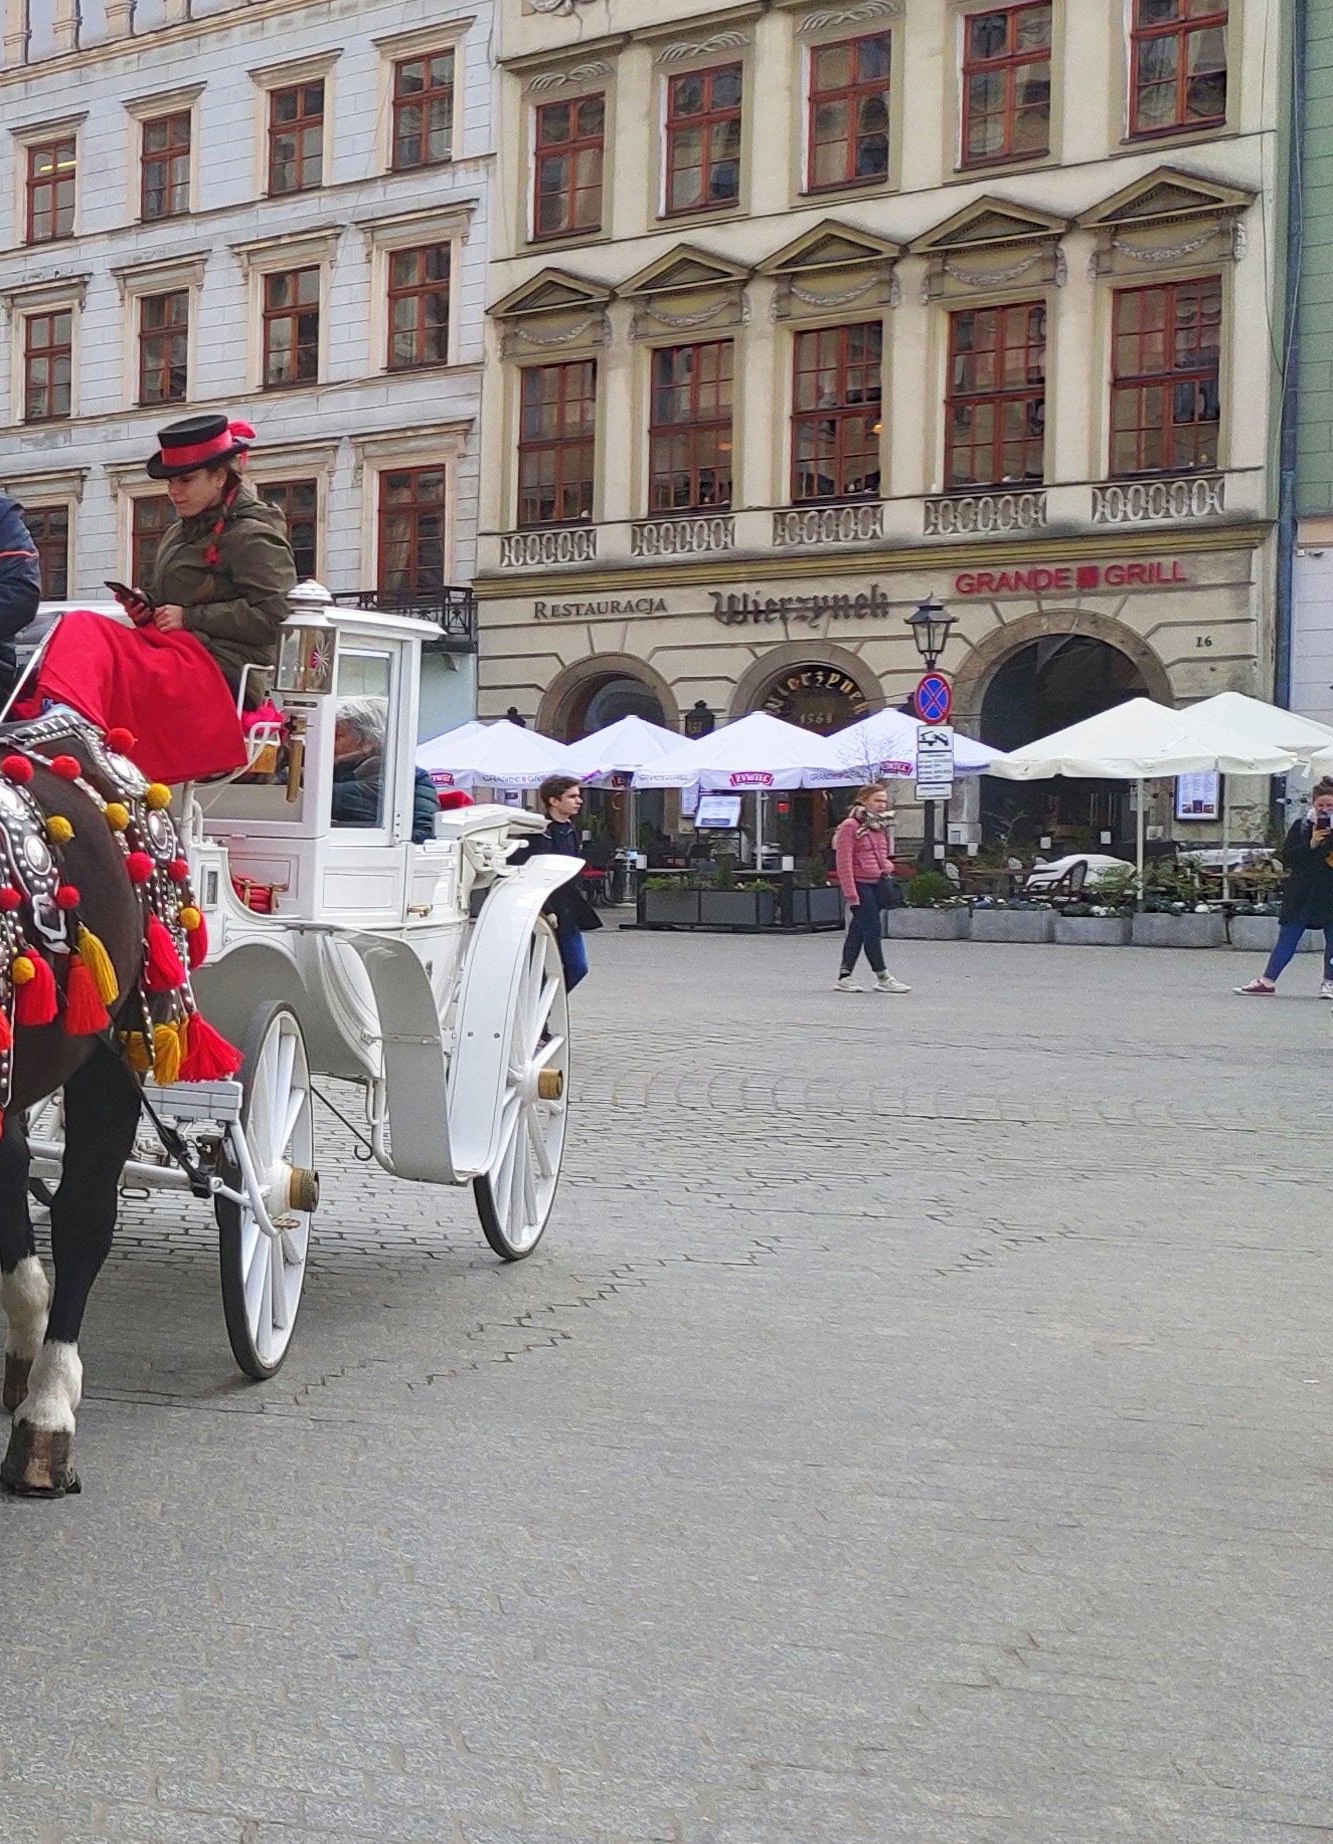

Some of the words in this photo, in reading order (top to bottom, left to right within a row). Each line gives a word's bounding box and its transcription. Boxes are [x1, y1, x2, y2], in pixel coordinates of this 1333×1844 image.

[955, 567, 1072, 595] GRANDE
[1104, 561, 1188, 587] GRILL
[533, 598, 668, 620] RESTAURACJA
[707, 583, 890, 629] Wierzynek
[1196, 636, 1213, 648] 16
